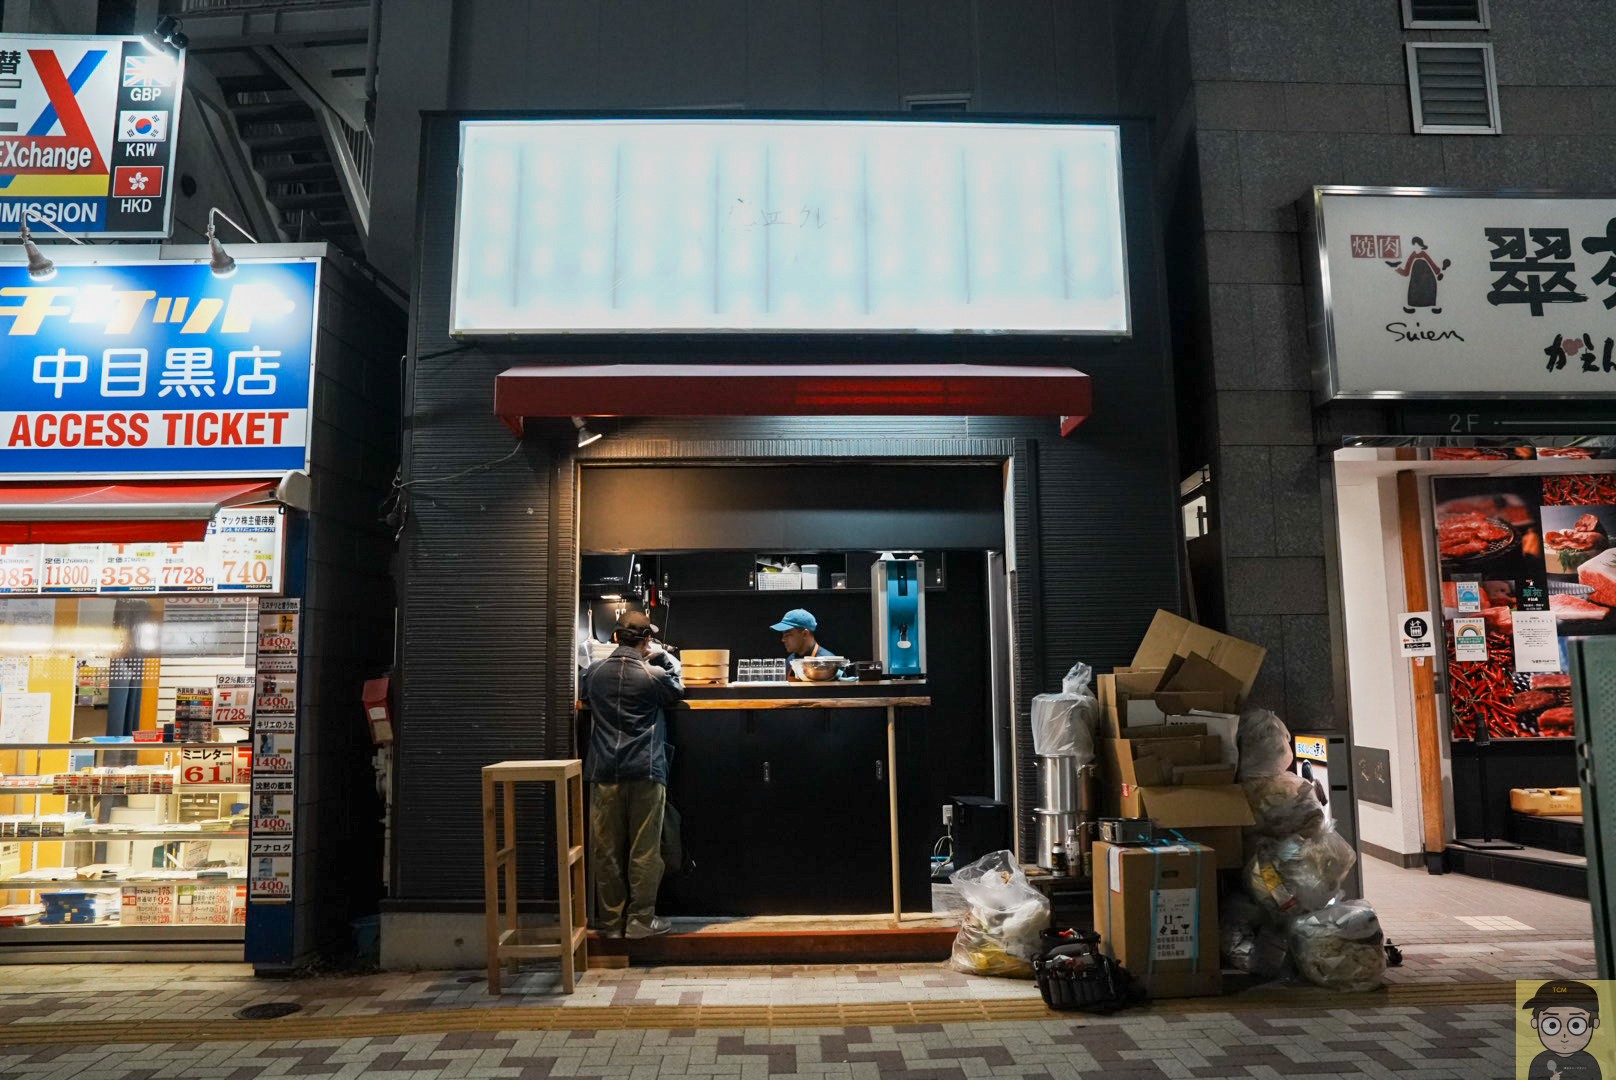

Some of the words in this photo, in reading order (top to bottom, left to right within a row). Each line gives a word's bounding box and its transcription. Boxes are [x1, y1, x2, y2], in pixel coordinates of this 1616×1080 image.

[130, 88, 162, 102] GBP
[125, 143, 157, 157] KRW
[0, 202, 98, 223] MISSION
[120, 198, 152, 213] HKD
[1351, 235, 1401, 258] 焼肉
[0, 284, 296, 335] チケット
[1386, 322, 1464, 343] Suien
[32, 345, 282, 399] 中目黒店
[8, 412, 149, 447] ACCESS
[162, 411, 289, 446] TICKET
[1450, 414, 1480, 433] 2F
[221, 515, 275, 526] マック株主優待券
[257, 721, 294, 729] キリエのうた
[183, 748, 232, 760] ミニレター
[255, 782, 293, 790] 沈黙の艦隊
[157, 896, 170, 905] 92
